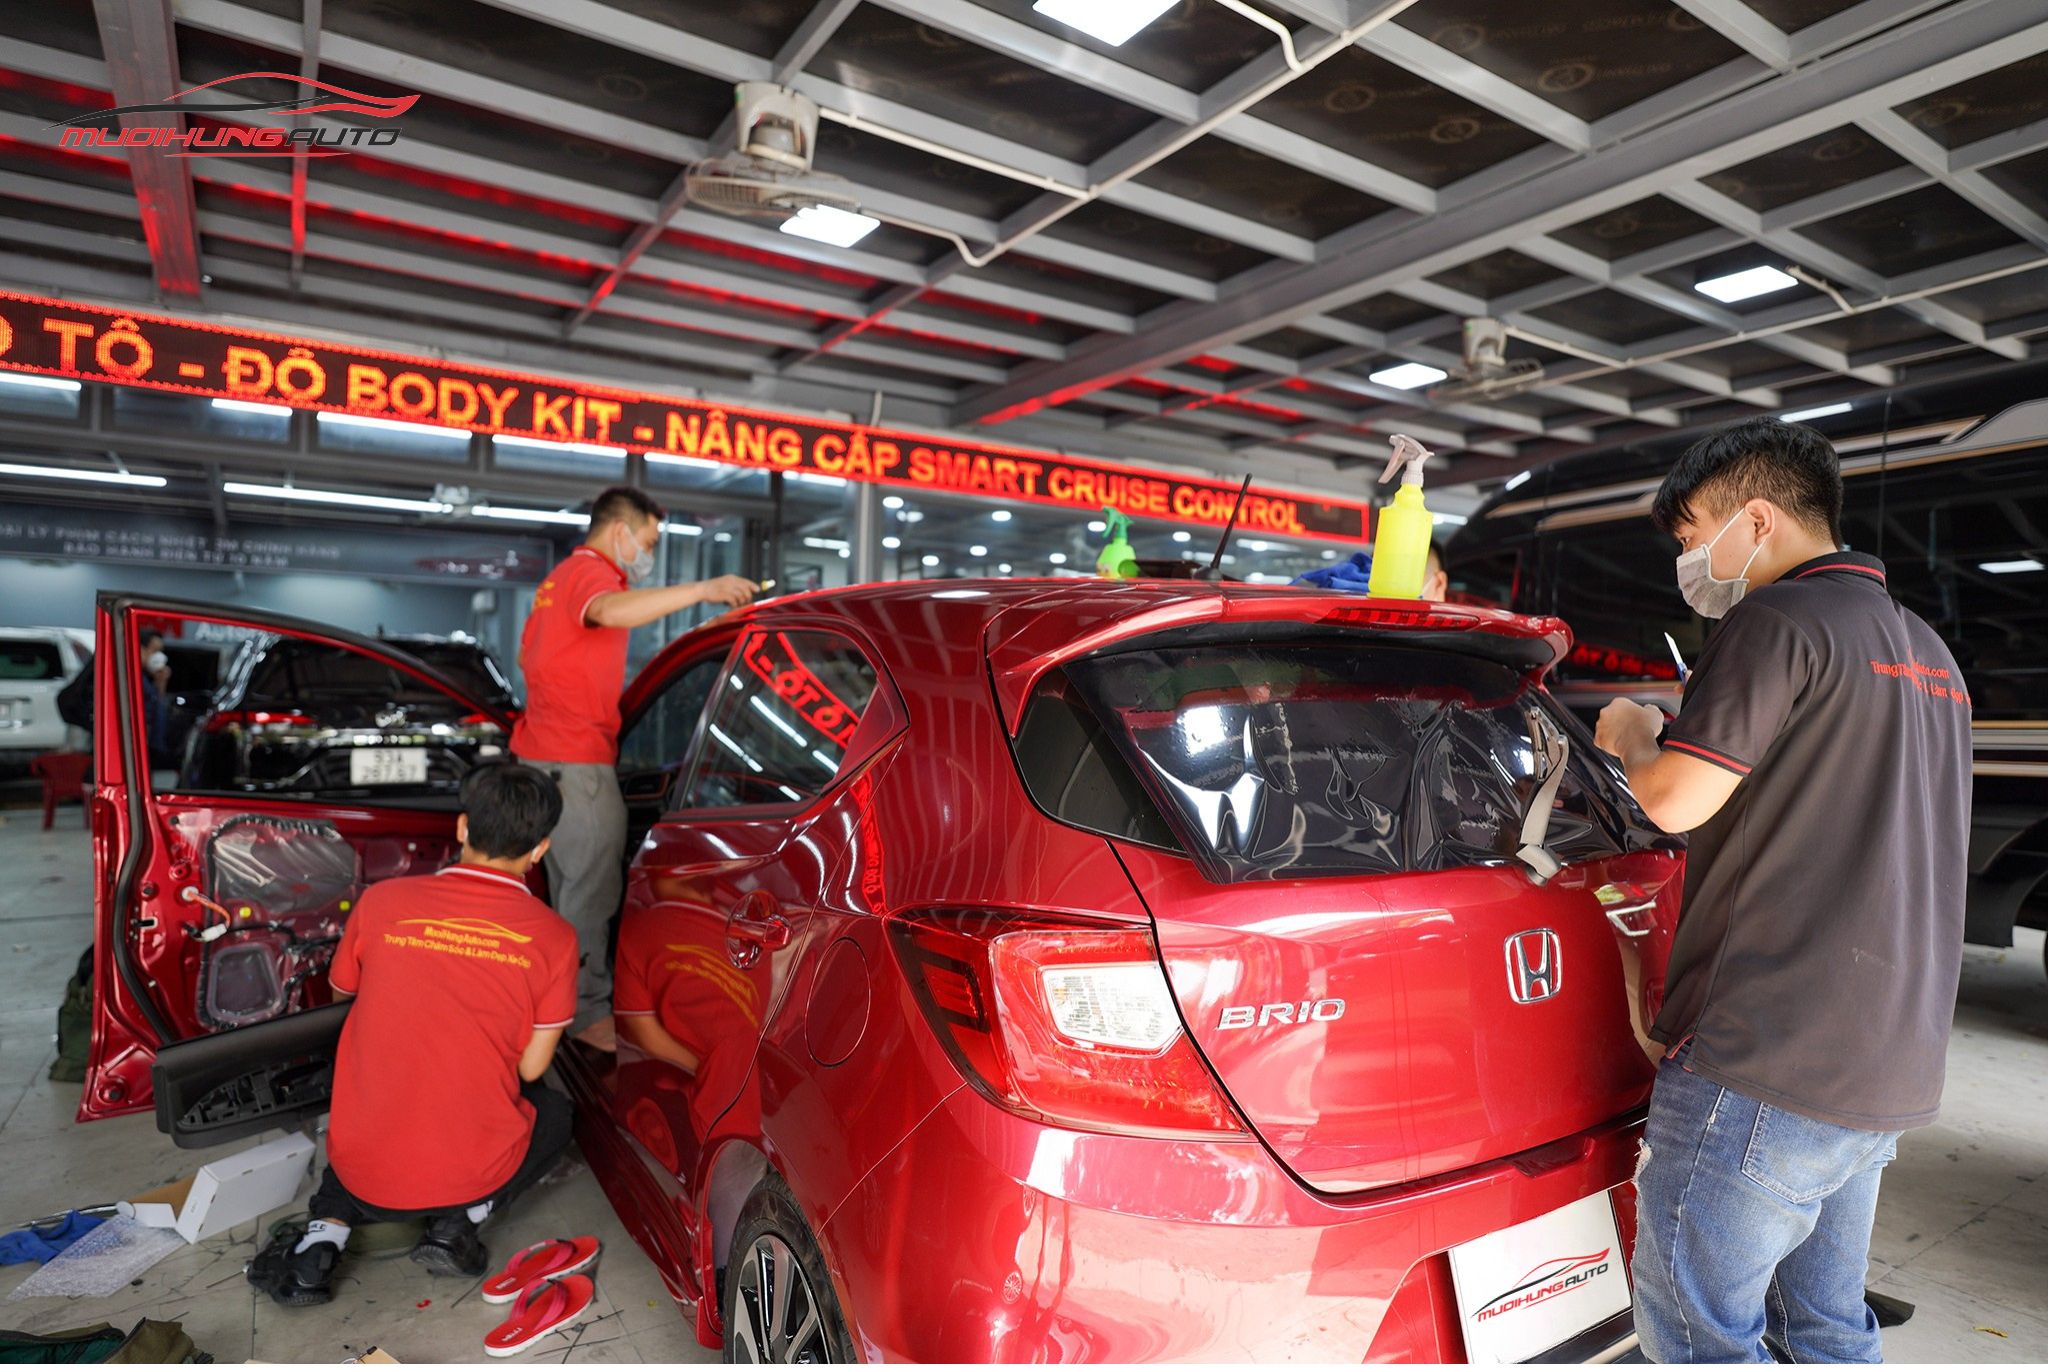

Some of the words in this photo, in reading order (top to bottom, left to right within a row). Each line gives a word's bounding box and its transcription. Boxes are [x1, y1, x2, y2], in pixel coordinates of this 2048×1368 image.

[43, 317, 154, 380] TÔ
[346, 363, 520, 430] BODY
[532, 390, 623, 445] KIT
[665, 409, 802, 468] NÂNG
[908, 447, 1044, 498] SMART
[1048, 466, 1170, 513] CRUISE
[1172, 485, 1306, 534] CONTROL
[384, 933, 407, 947] Trung
[1214, 997, 1347, 1031] BRIO
[1477, 1262, 1609, 1323] MUOIHUNGAUTO
